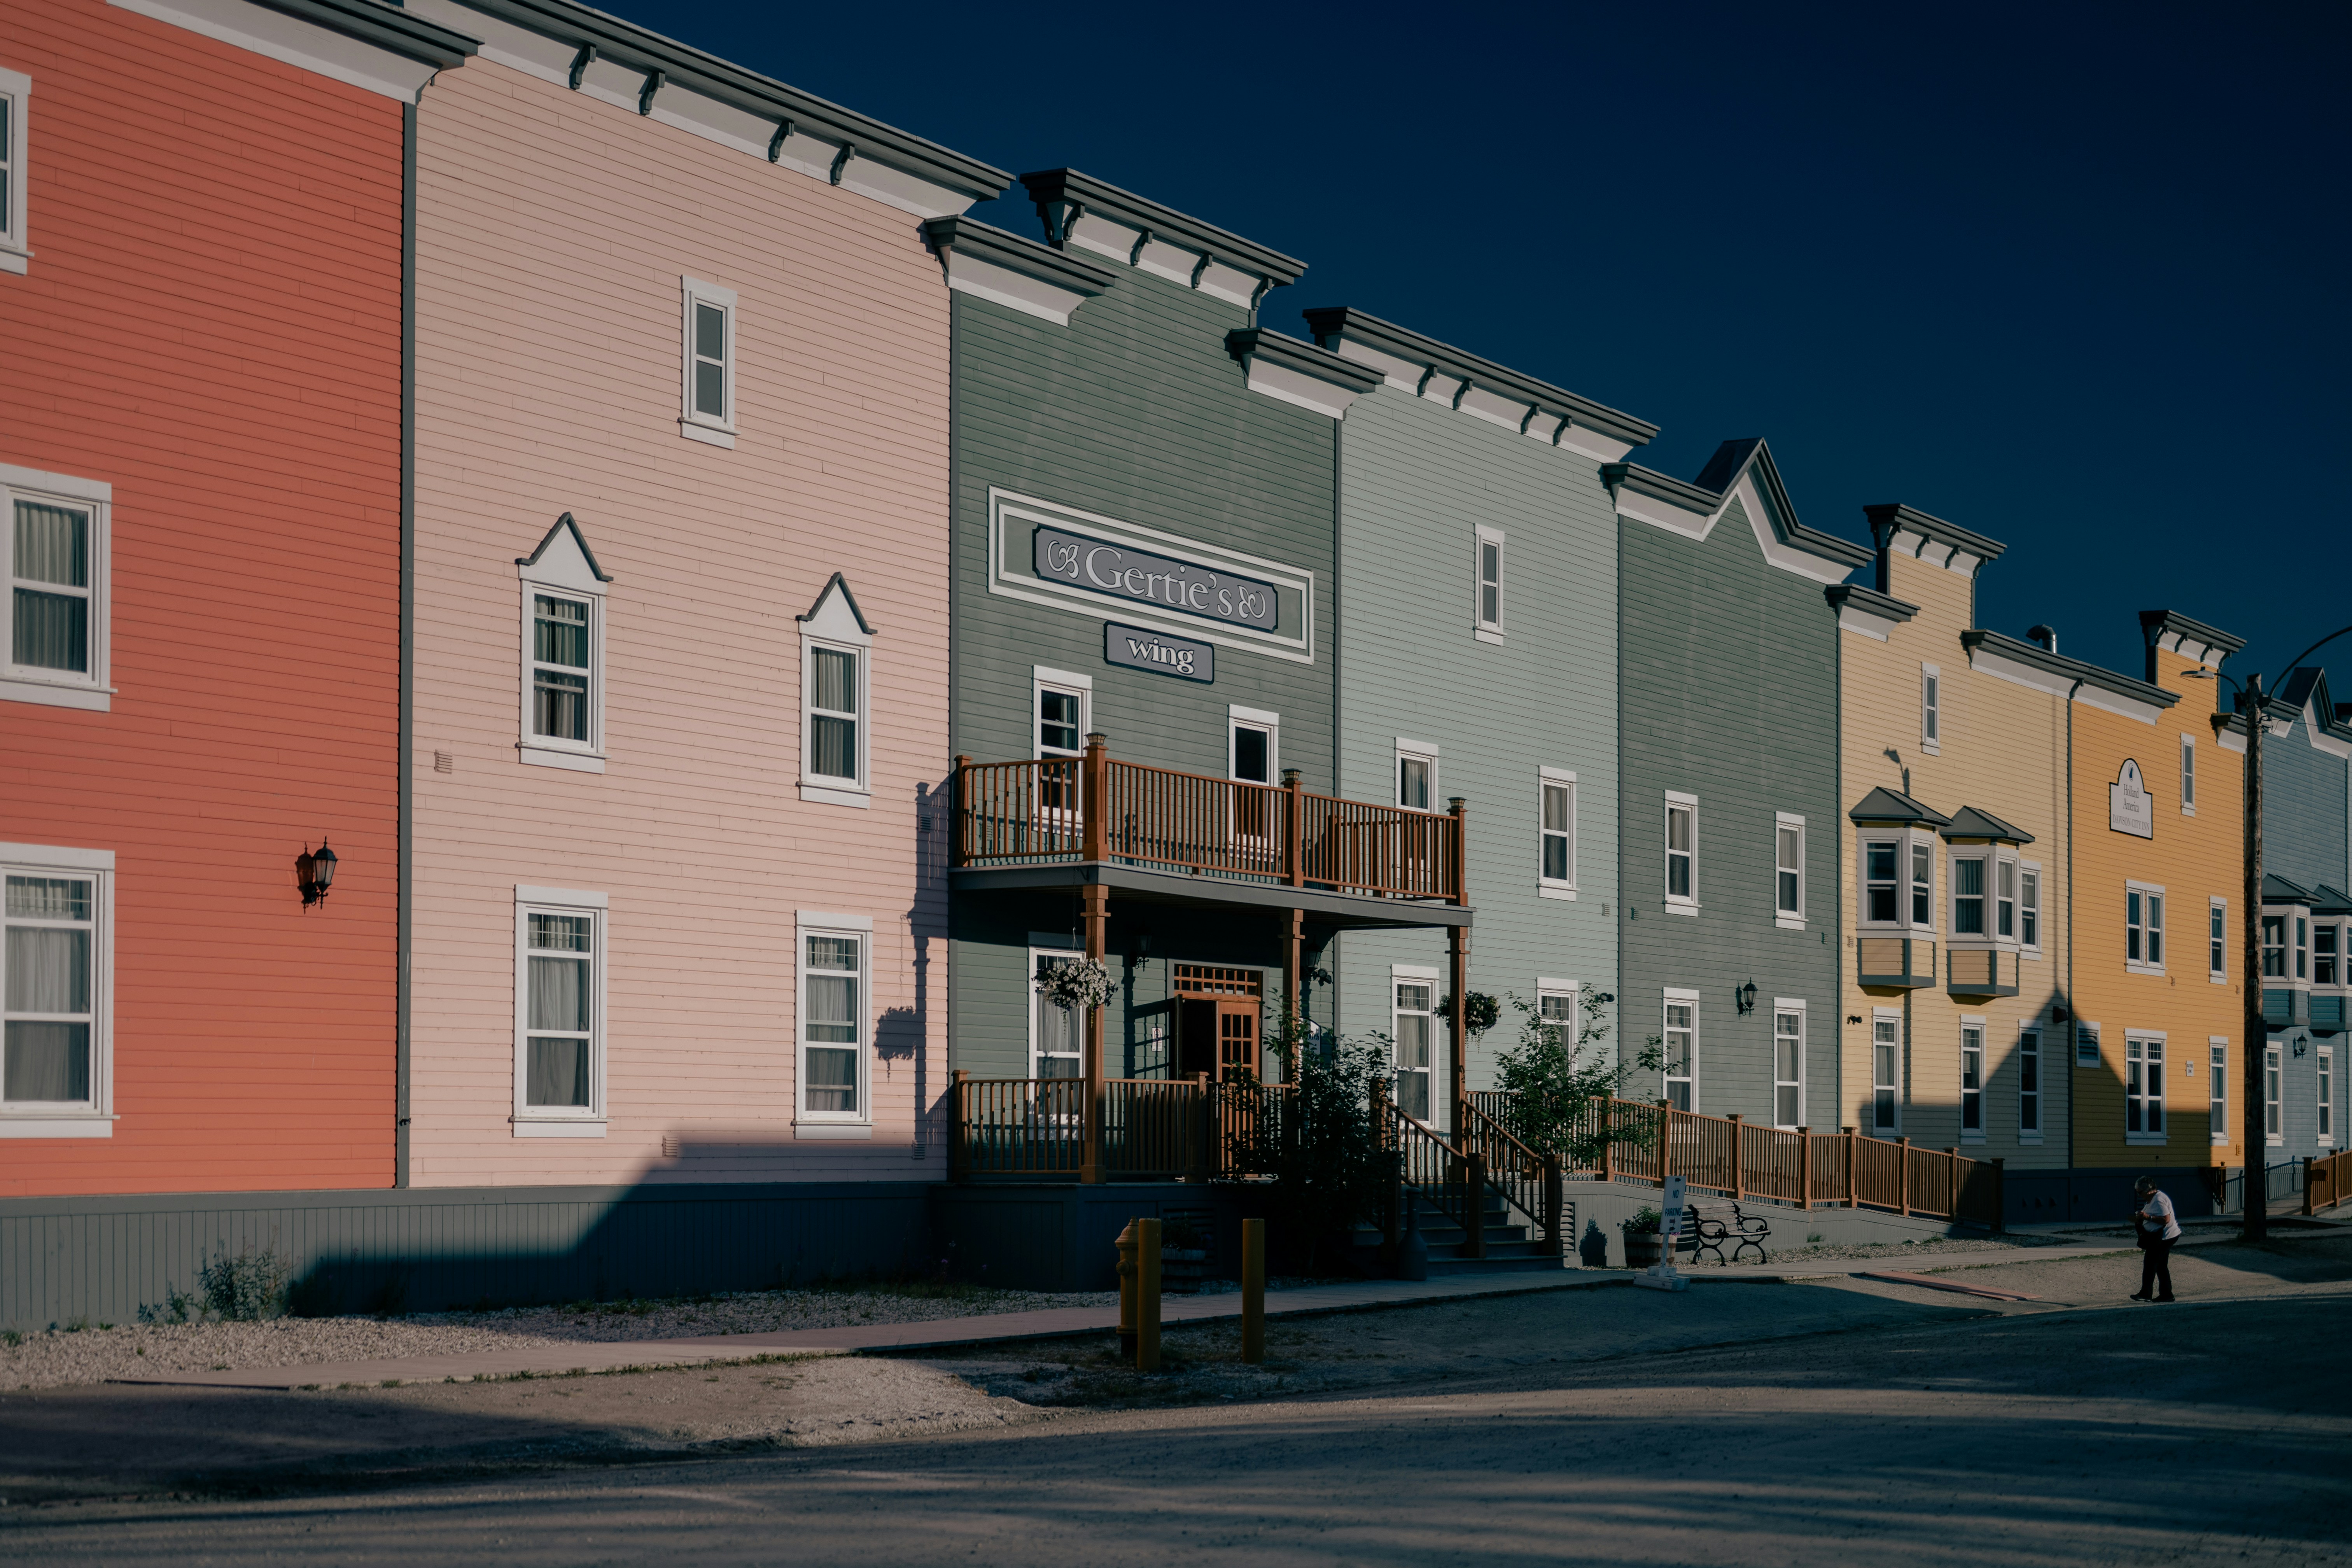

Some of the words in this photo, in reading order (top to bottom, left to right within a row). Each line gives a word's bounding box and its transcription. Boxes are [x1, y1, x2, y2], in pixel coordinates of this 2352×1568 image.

[1085, 546, 1232, 616] Gertie's
[1126, 638, 1195, 675] wing
[2123, 784, 2139, 798] Holland
[2123, 798, 2139, 813] America
[2112, 814, 2131, 826] DAWSON
[2132, 819, 2142, 829] CITY
[1672, 1190, 1679, 1199] NO
[1665, 1208, 1682, 1217] PARKING
